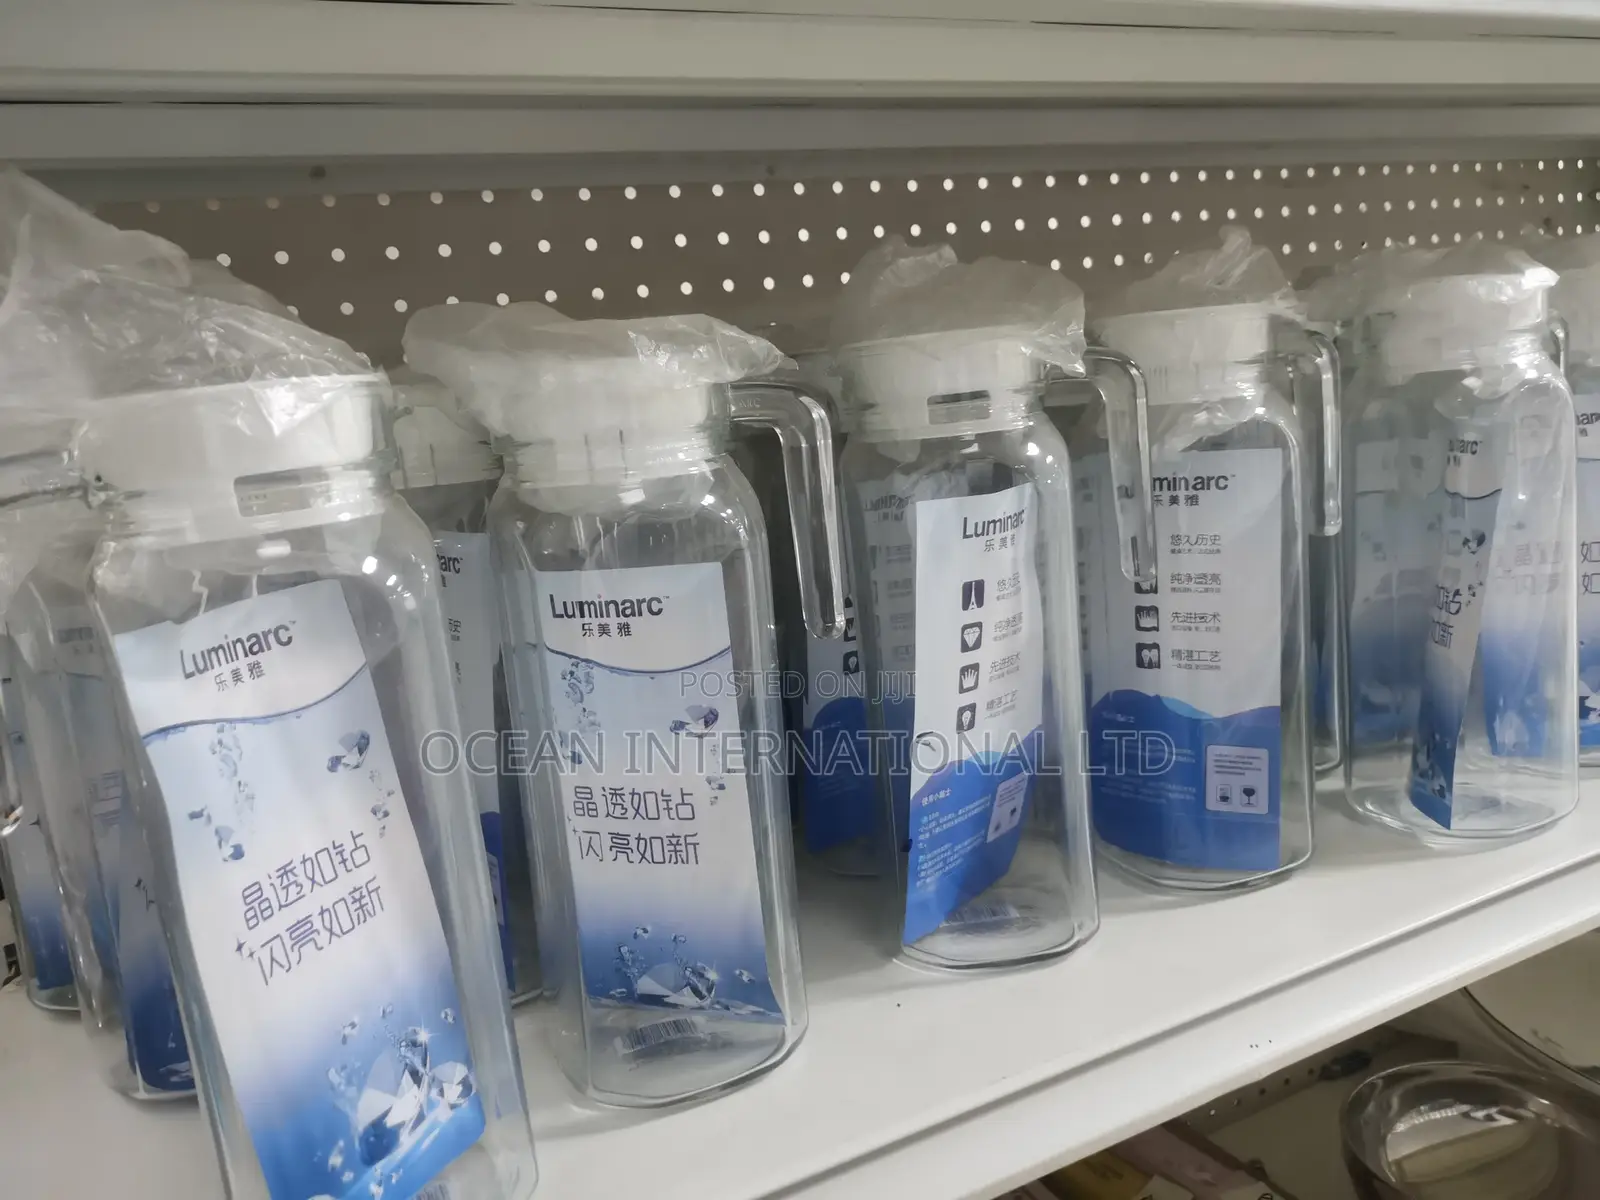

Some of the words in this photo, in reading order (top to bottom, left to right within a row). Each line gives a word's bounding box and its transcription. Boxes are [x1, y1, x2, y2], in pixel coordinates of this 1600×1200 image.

[1152, 471, 1229, 492] minarc
[962, 509, 1025, 539] Luminarc
[549, 594, 664, 619] Luminarc
[581, 621, 633, 638] 乐美雅
[180, 624, 293, 679] Luminarc
[214, 660, 265, 692] 乐美雅
[573, 786, 696, 821] 晶透如钻
[578, 832, 700, 865] 闪亮如新
[242, 830, 371, 931] 晶透如钻
[258, 876, 384, 986] 闪亮如新
